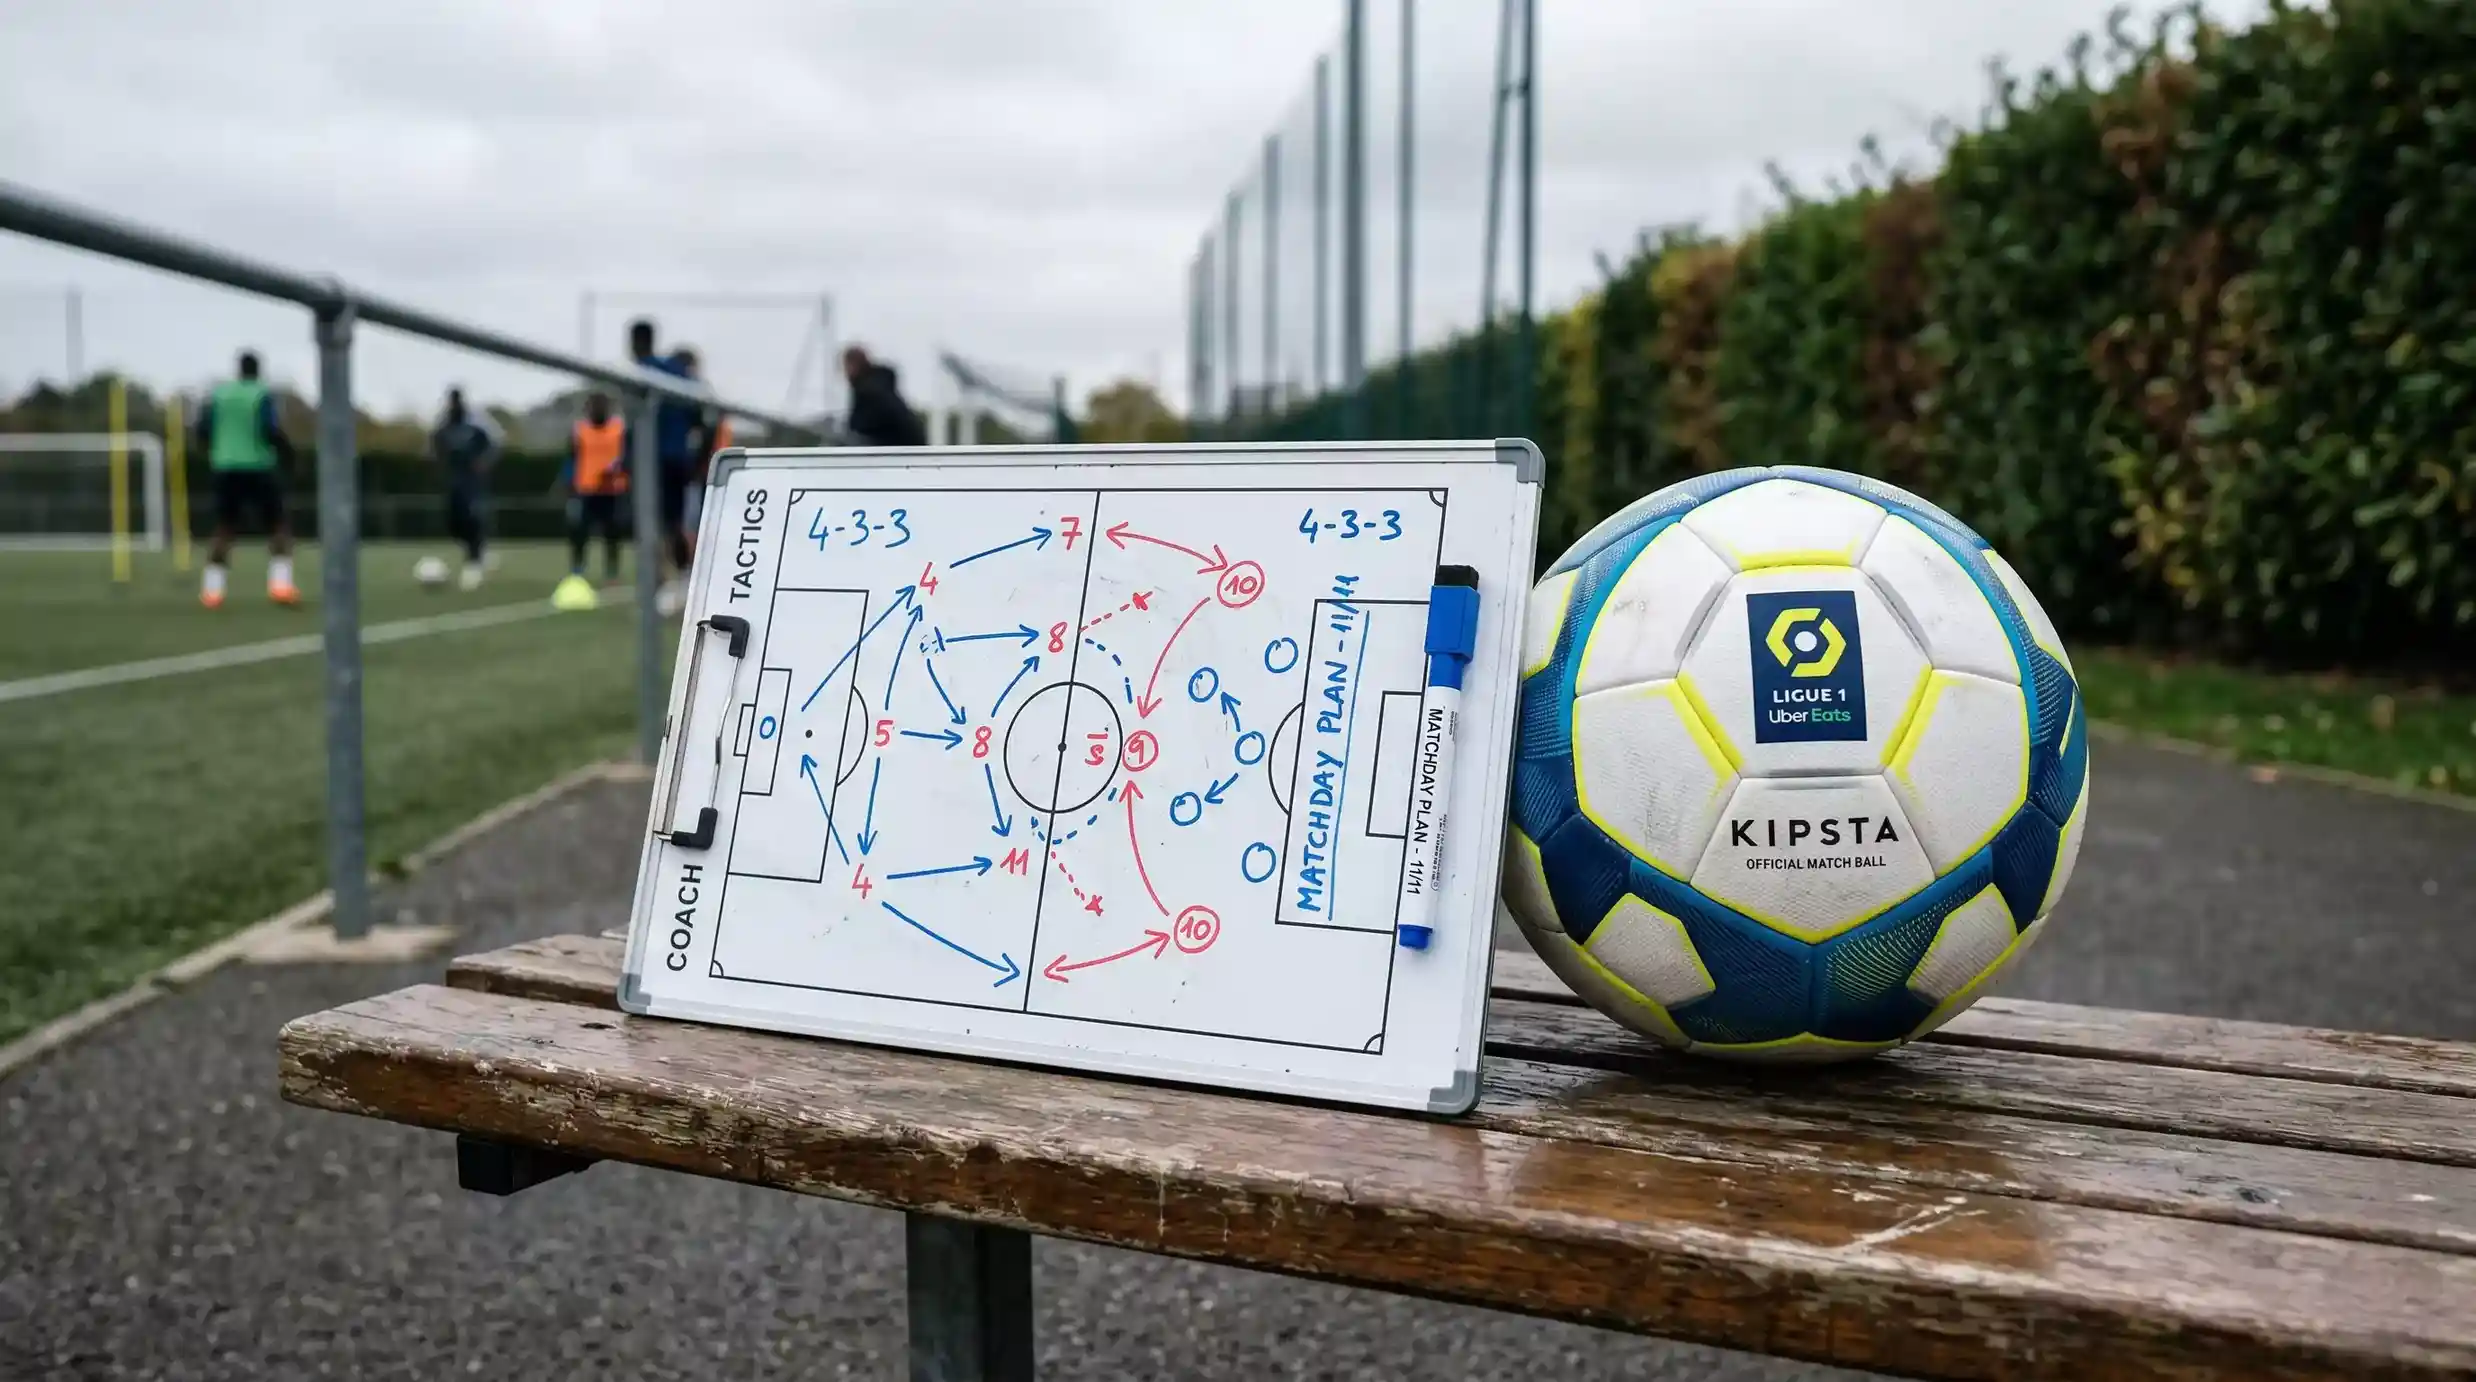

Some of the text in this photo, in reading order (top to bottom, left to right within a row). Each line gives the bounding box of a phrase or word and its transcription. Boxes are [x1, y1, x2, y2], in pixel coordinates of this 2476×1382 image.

[808, 507, 911, 551] 4-3-3
[1060, 516, 1083, 550] 7
[1299, 508, 1402, 543] 4-3-3
[729, 488, 768, 604] TACTICS
[919, 562, 938, 596] 4
[1224, 575, 1257, 596] 10
[1048, 621, 1068, 654] 8
[1316, 661, 1348, 734] PLAN
[1773, 688, 1847, 703] LIGUE 1
[1769, 708, 1851, 724] Uber Eats
[874, 719, 894, 748] 5
[972, 726, 993, 759] 8
[1420, 708, 1443, 796] MATCHDAY
[1296, 750, 1344, 912] MATCHDAY
[1413, 799, 1432, 843] PLAN
[1731, 816, 1899, 847] KIPSTA
[1000, 847, 1029, 876] 11
[1406, 861, 1425, 895] 11/11
[1746, 855, 1887, 870] OFFICIAL MATCH BALL
[851, 863, 873, 900] 4
[666, 863, 704, 972] COACH
[1180, 916, 1211, 940] 10
